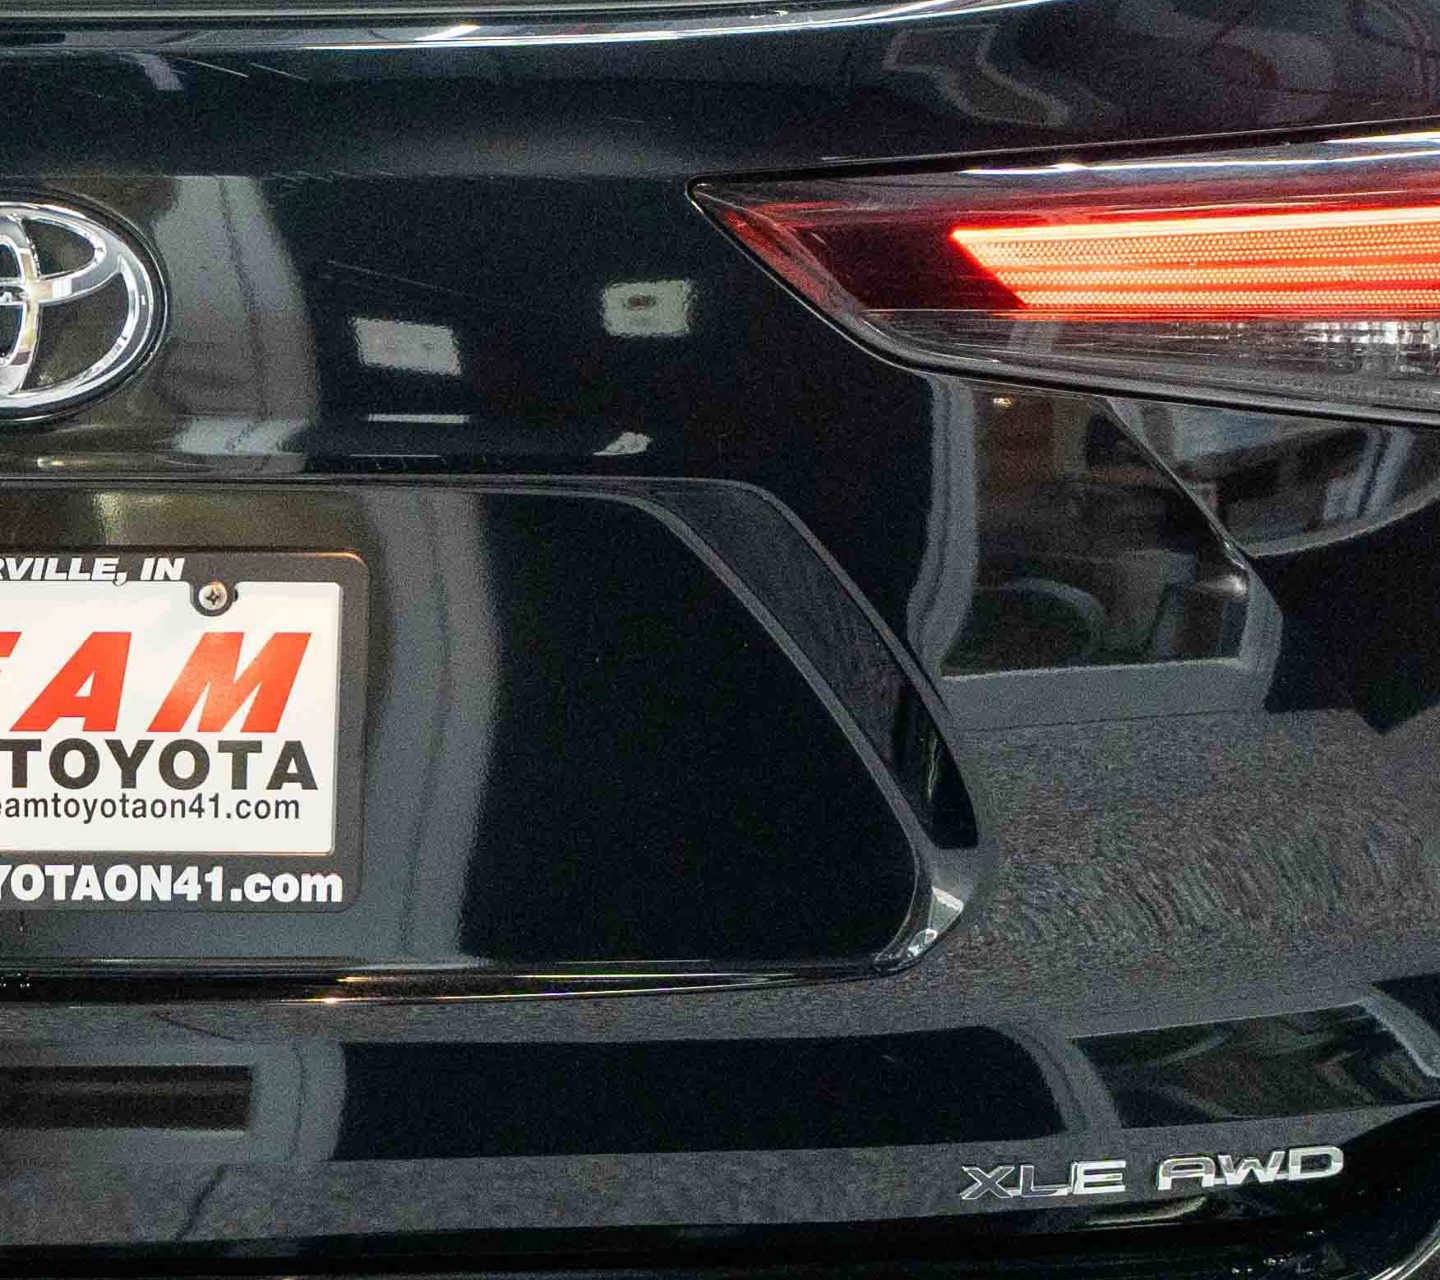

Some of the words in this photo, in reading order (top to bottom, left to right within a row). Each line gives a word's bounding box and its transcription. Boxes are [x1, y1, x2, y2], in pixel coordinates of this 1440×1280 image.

[140, 558, 185, 581] IN
[959, 1160, 1127, 1200] XLE
[1157, 1145, 1344, 1190] AWD
